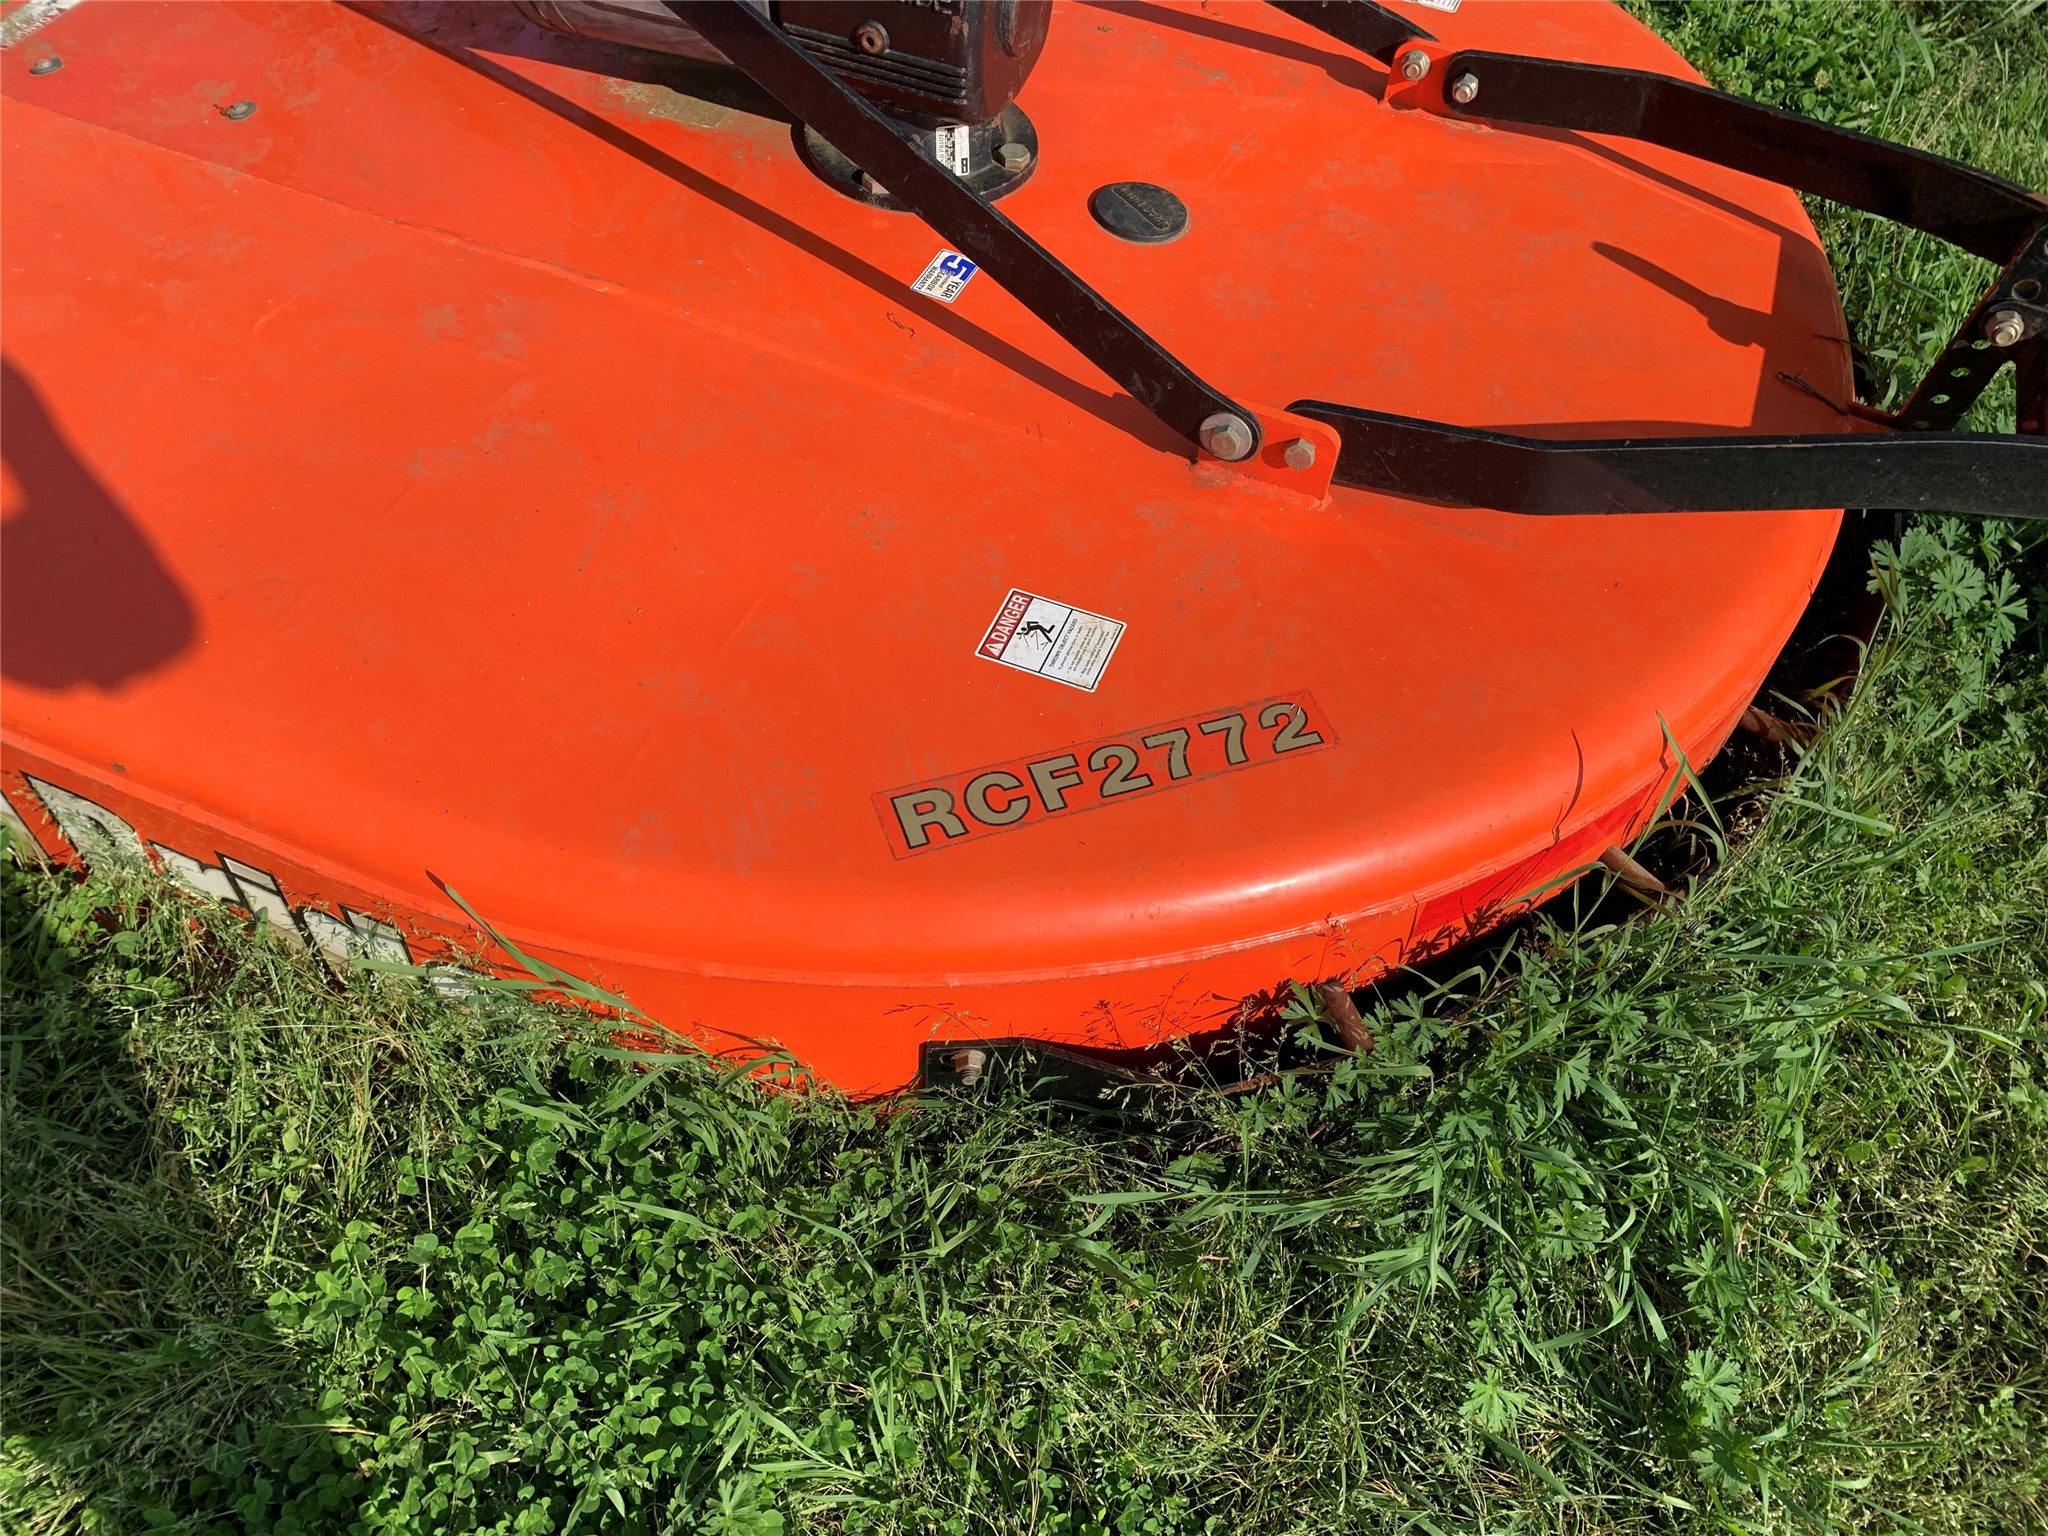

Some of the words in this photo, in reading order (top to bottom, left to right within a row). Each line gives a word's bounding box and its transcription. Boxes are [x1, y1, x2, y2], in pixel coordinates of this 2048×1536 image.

[916, 265, 939, 290] WARRANTY
[926, 268, 948, 291] GEARBOX
[940, 255, 977, 281] 5
[941, 280, 962, 298] YEAR
[993, 594, 1029, 643] DANGER
[891, 701, 1324, 849] RCF2772
